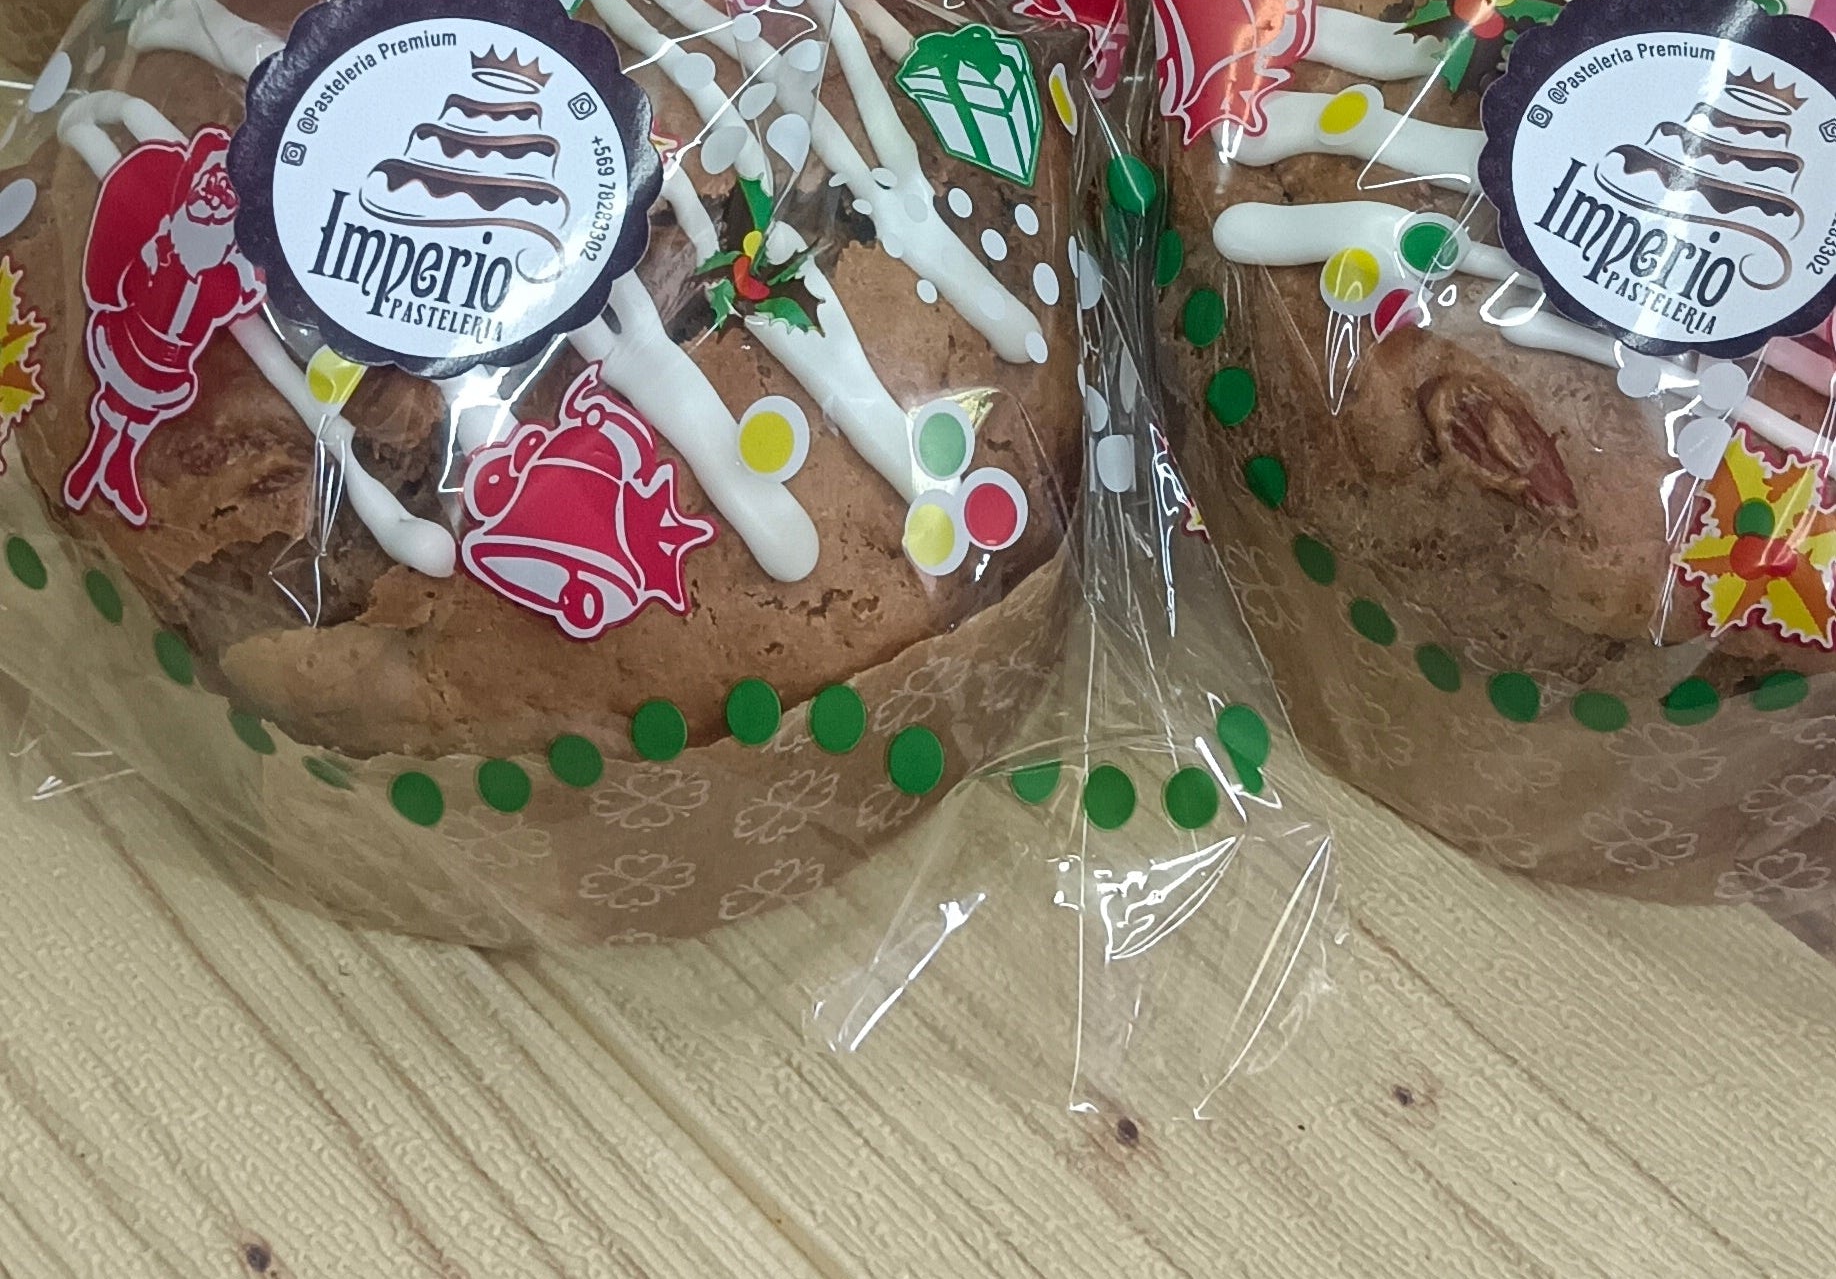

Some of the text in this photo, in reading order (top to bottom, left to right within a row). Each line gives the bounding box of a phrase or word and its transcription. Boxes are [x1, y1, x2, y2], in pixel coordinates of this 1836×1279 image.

[377, 30, 458, 60] Premium
[1637, 41, 1716, 62] Premium
[579, 135, 617, 263] +569 78283302
[308, 189, 514, 319] Imperio
[1534, 156, 1736, 309] Imperio
[388, 298, 505, 344] PASTELERIA
[1603, 270, 1717, 336] PASTELERIA
